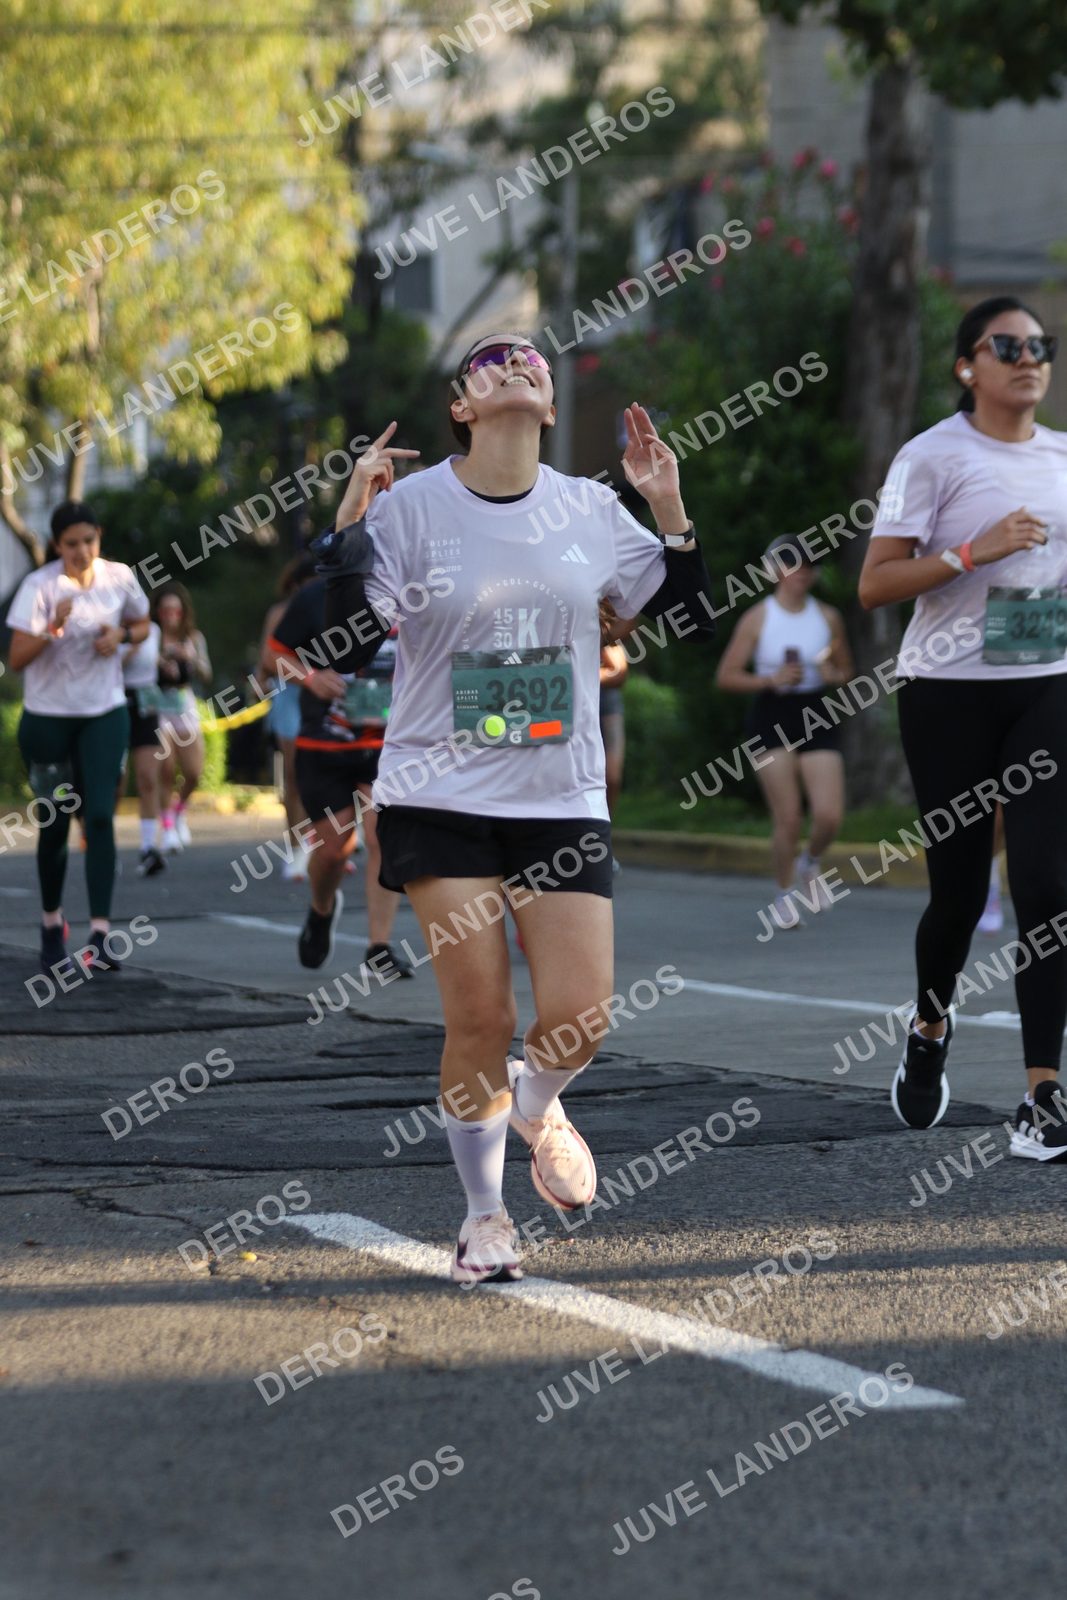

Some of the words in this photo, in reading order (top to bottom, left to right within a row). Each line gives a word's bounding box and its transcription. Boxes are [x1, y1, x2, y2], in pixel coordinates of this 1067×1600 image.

[493, 608, 513, 624] 15
[518, 608, 542, 649] K
[493, 632, 513, 649] 30
[486, 676, 569, 713] 3692
